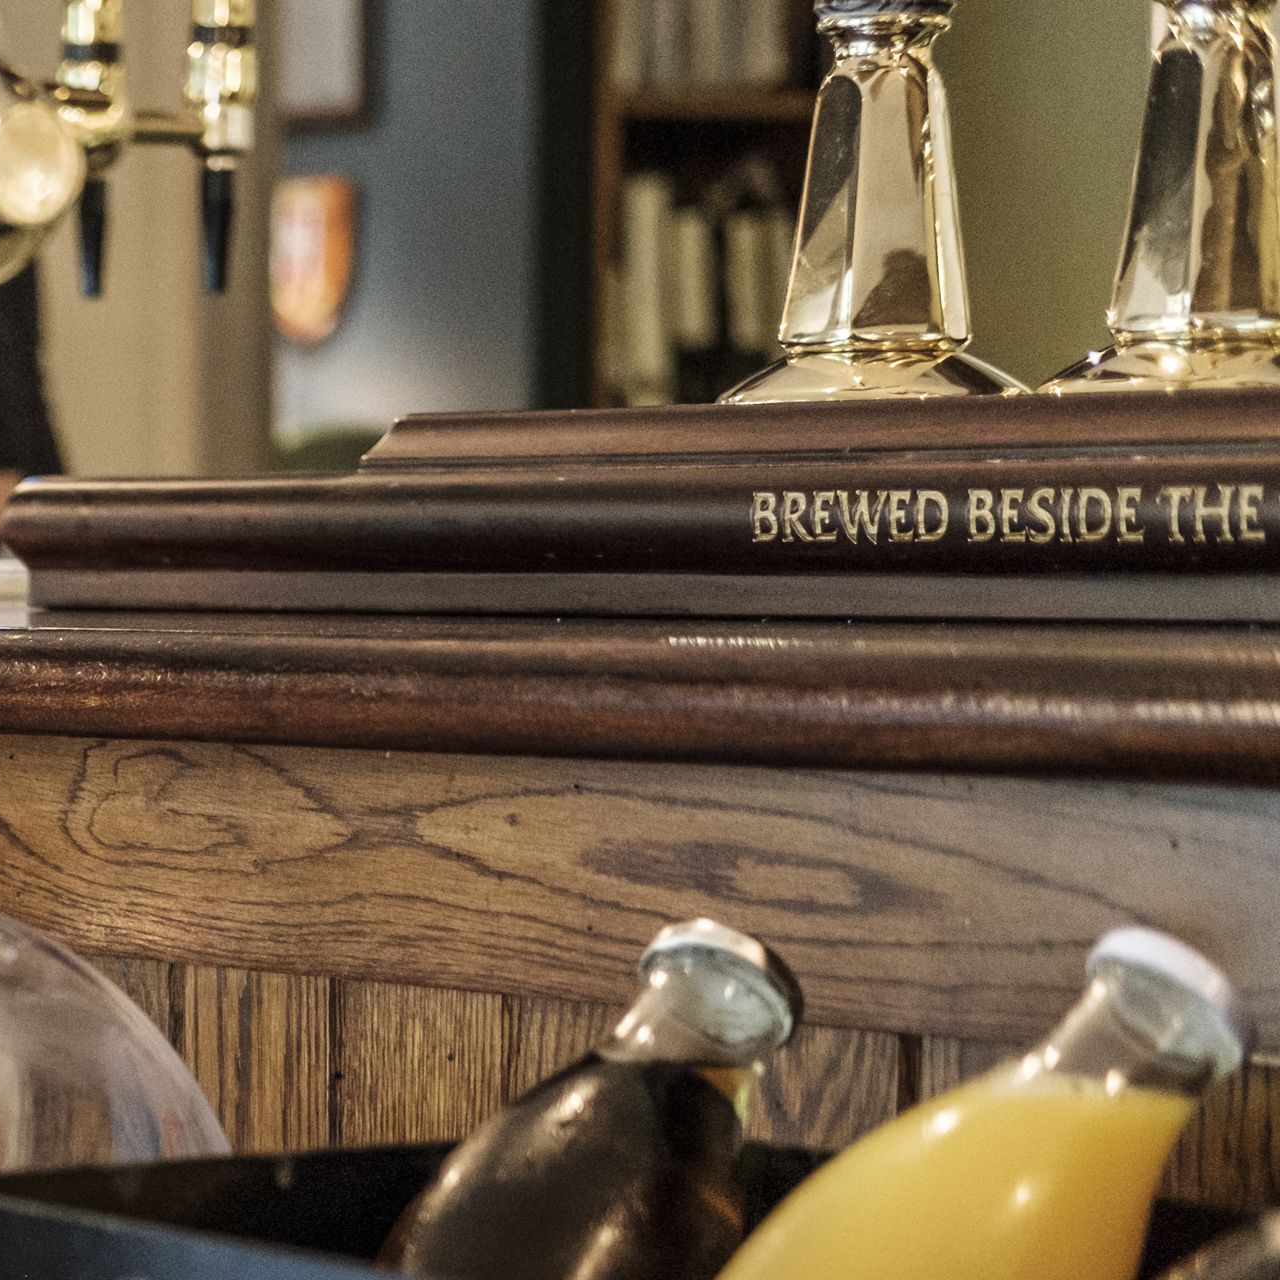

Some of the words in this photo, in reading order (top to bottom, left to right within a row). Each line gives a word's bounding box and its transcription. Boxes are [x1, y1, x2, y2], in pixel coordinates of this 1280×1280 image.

[751, 488, 949, 545] BREWED
[966, 487, 1144, 544] BESIDE
[1160, 482, 1267, 543] THE
